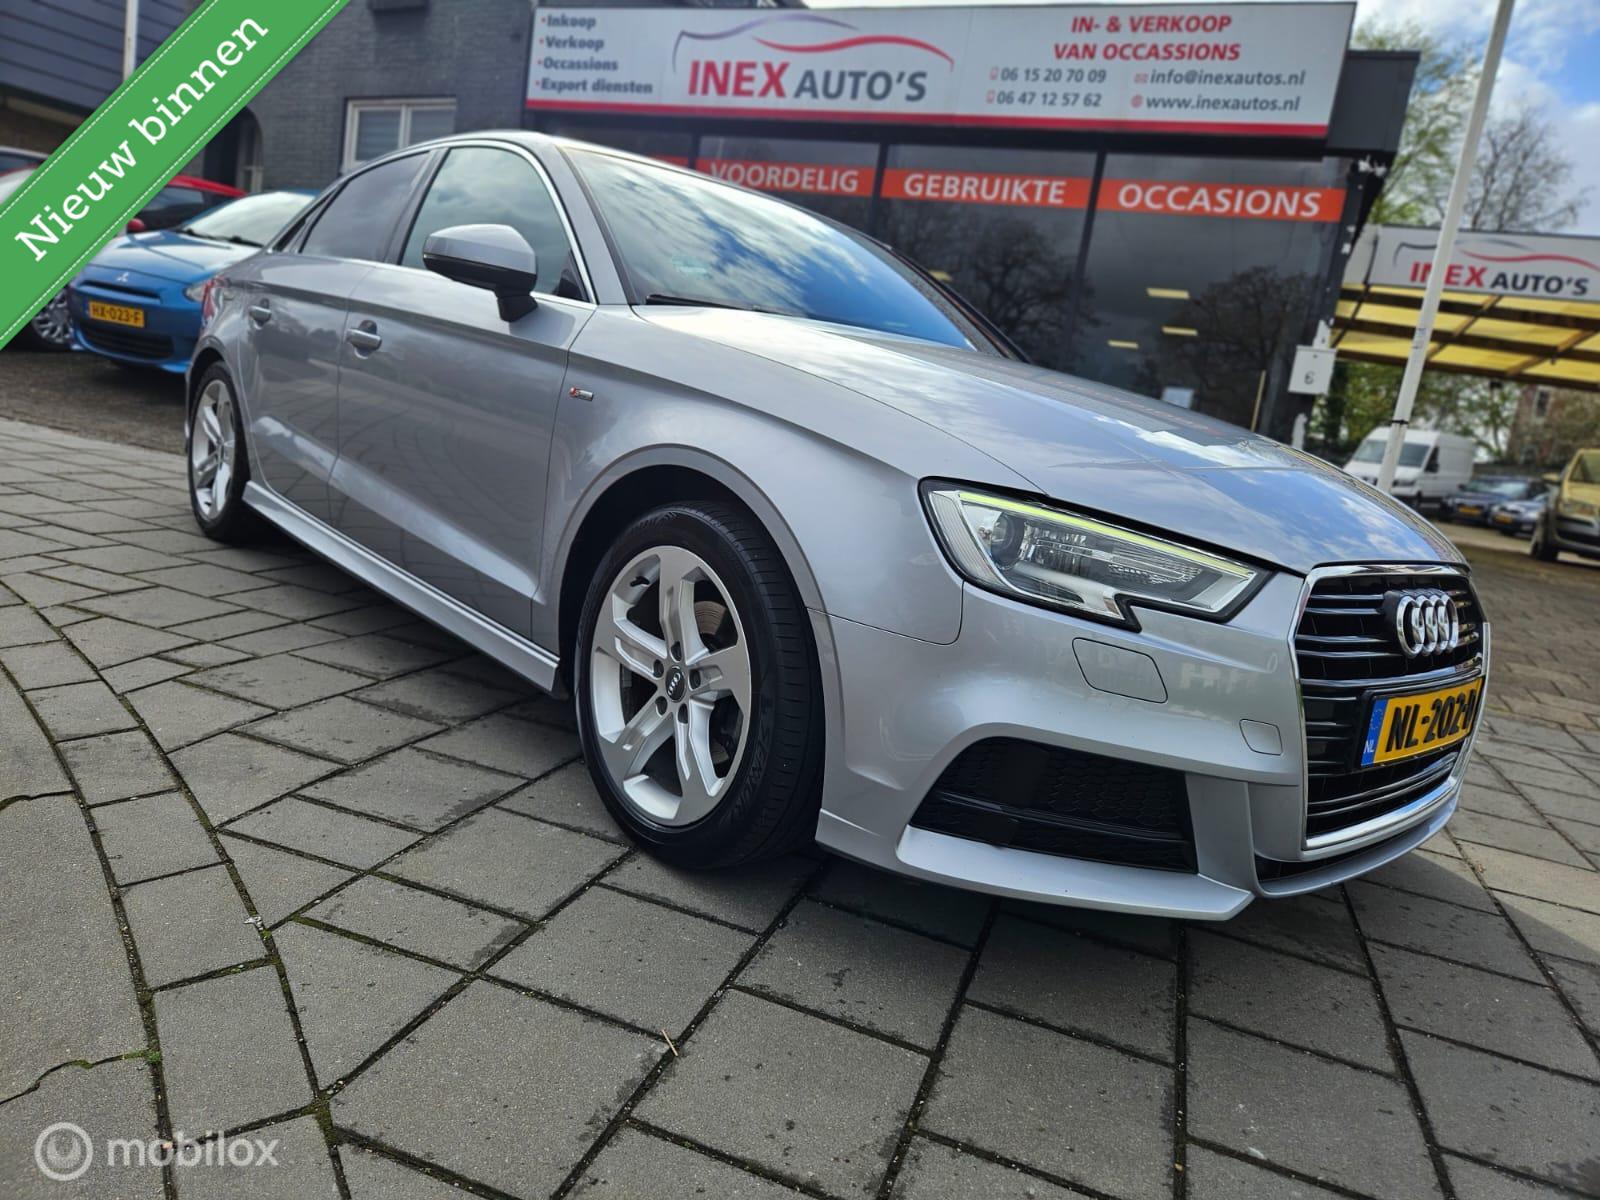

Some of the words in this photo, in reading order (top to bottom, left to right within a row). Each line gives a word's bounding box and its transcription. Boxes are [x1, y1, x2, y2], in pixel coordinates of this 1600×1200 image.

[547, 14, 596, 31] Inkoop
[1071, 16, 1099, 32] IN-
[1106, 16, 1121, 33] &
[1129, 16, 1231, 33] VERKOOP
[546, 36, 604, 53] Verkoop
[1054, 44, 1098, 60] VAN
[1102, 43, 1241, 61] OCCASSIONS
[543, 57, 618, 72] Occassions
[688, 61, 789, 98] INEX
[794, 70, 927, 101] AUTO'S
[1001, 68, 1018, 82] 06
[1024, 69, 1040, 82] 15
[1043, 69, 1062, 82] 20
[1066, 69, 1085, 83] 70
[1088, 69, 1106, 83] 09
[1150, 69, 1305, 86] info@inexautos.nl
[541, 78, 587, 94] Export
[591, 79, 653, 94] diensten
[997, 91, 1014, 105] 06
[1018, 92, 1036, 105] 47
[1041, 93, 1058, 106] 12
[1062, 94, 1080, 107] 57
[1083, 94, 1102, 107] 62
[1146, 96, 1300, 111] www.inexautos.nl
[709, 162, 859, 192] VOORDELIG
[903, 174, 1066, 204] GEBRUIKTE
[1118, 183, 1322, 217] OCCASIONS
[1490, 272, 1589, 296] AUTO'S
